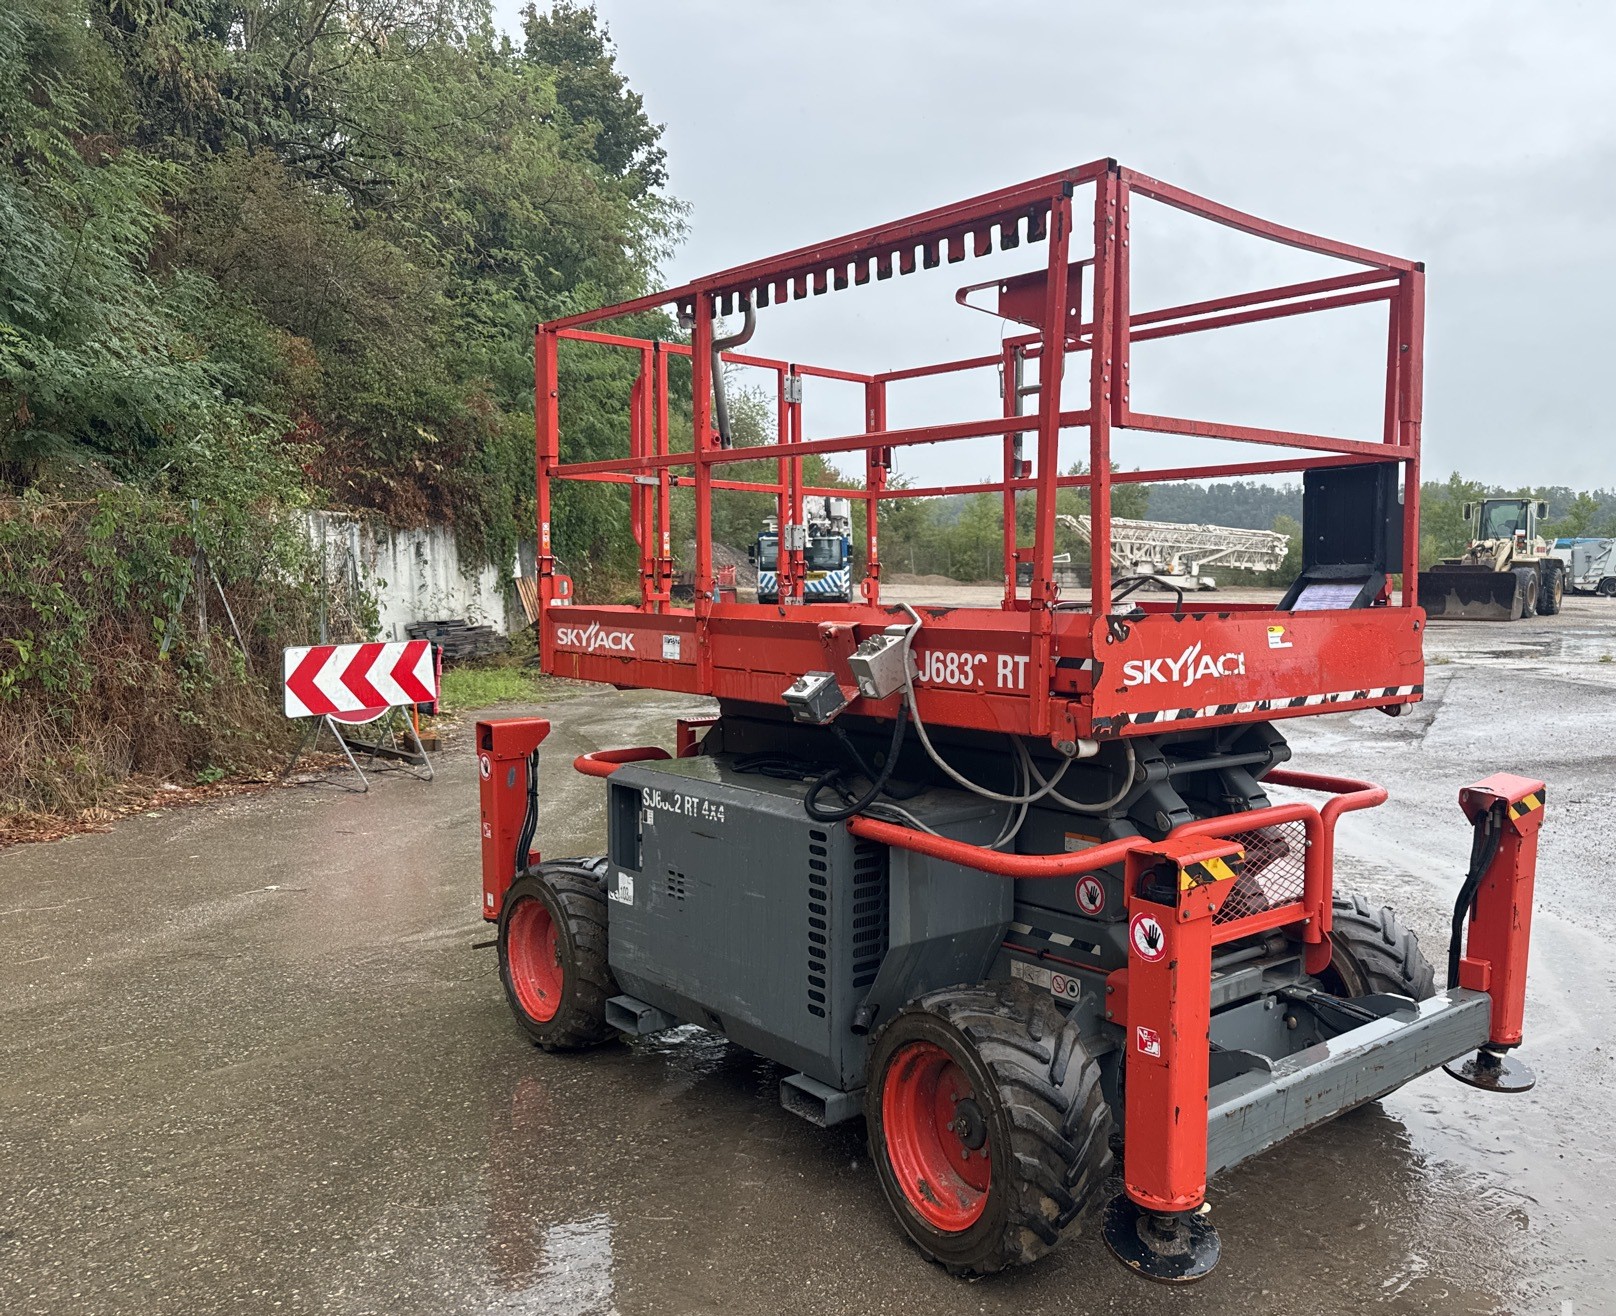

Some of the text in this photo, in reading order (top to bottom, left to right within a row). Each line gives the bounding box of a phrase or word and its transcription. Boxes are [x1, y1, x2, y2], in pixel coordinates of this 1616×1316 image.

[557, 620, 635, 651] SKYJACK
[997, 654, 1030, 689] RT
[643, 787, 681, 813] SJ62
[684, 796, 699, 817] RT
